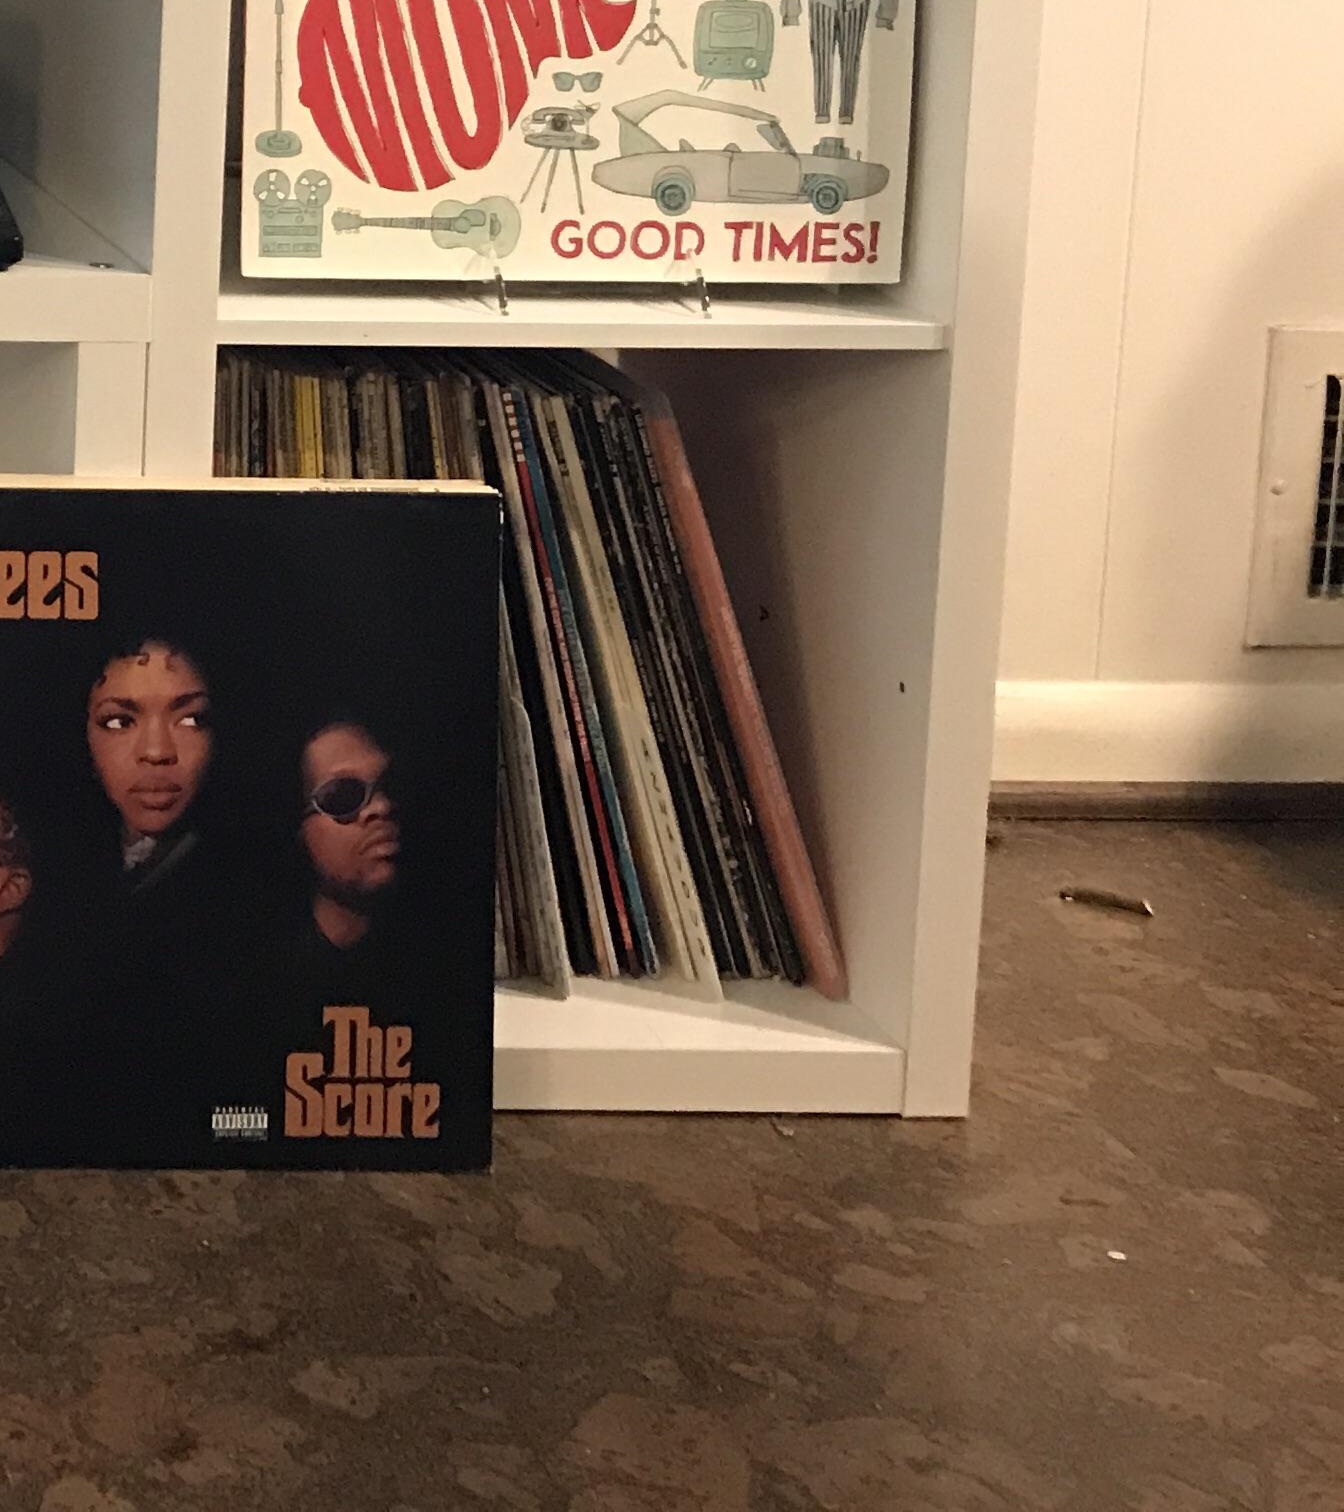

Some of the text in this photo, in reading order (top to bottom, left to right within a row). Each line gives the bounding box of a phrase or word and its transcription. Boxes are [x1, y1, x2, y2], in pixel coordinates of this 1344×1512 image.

[550, 220, 880, 264] GOOD TIMES!
[322, 1005, 412, 1079] The
[212, 1114, 268, 1129] ADVISORY
[284, 1052, 441, 1139] Score
